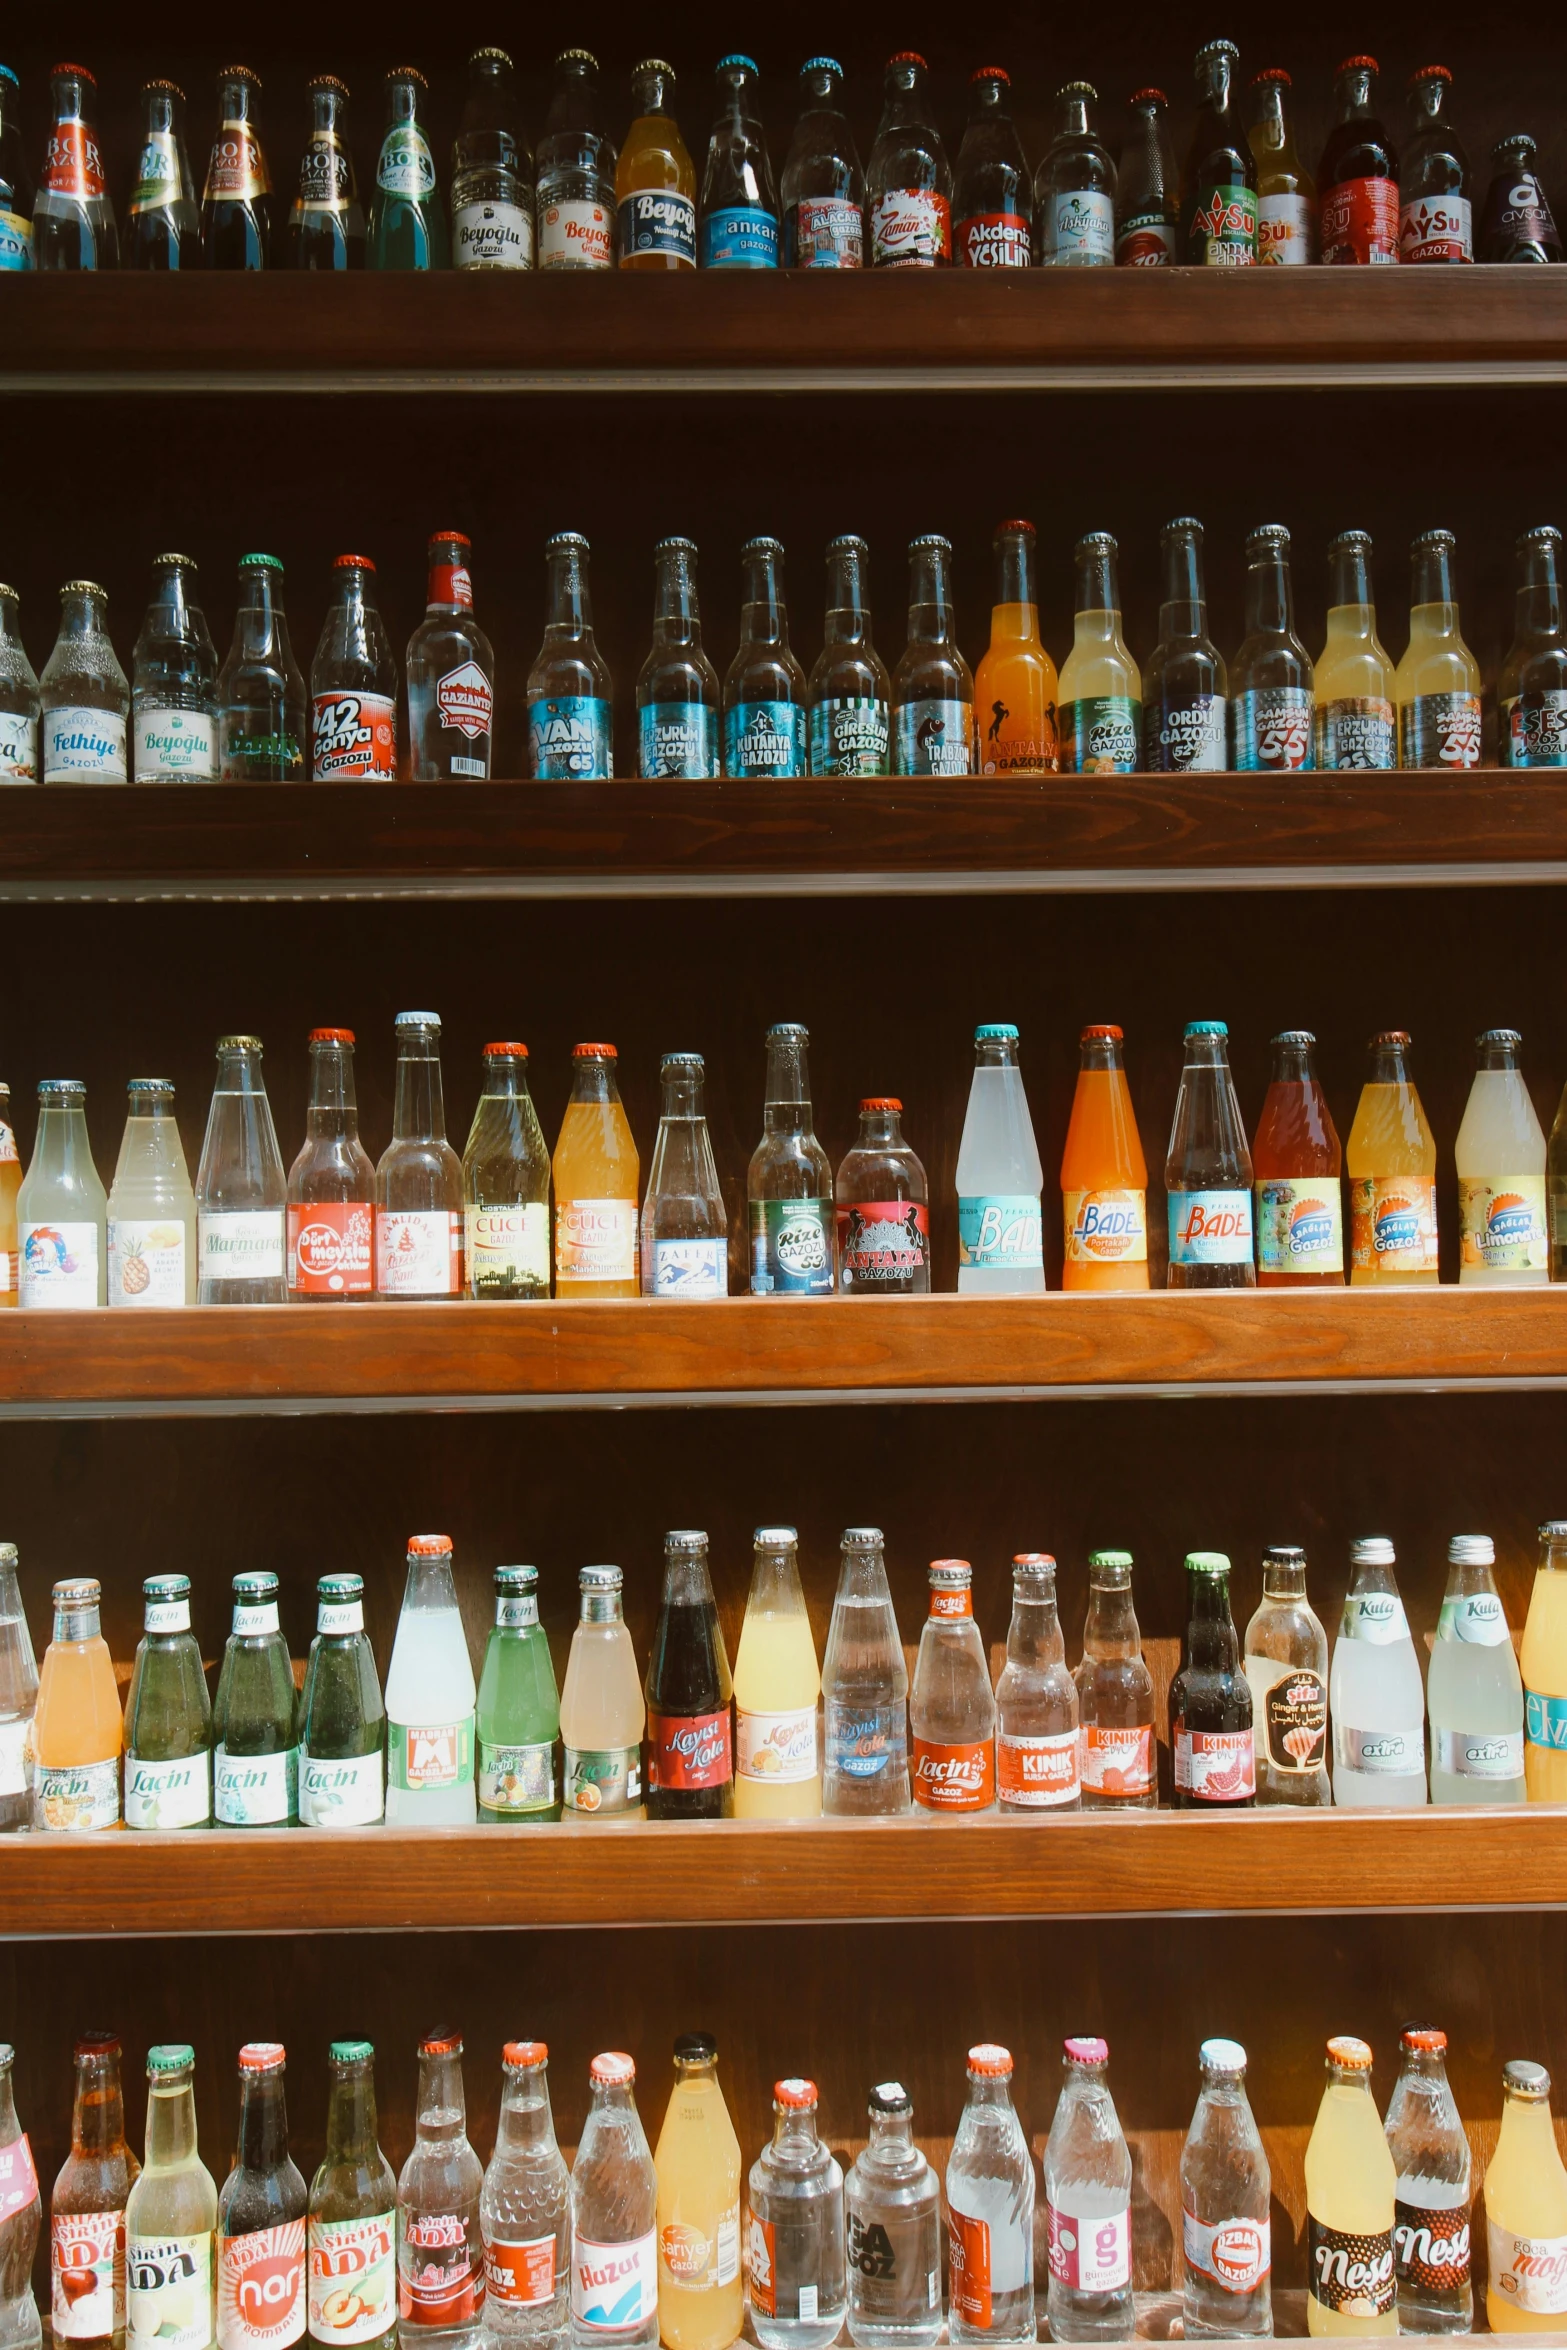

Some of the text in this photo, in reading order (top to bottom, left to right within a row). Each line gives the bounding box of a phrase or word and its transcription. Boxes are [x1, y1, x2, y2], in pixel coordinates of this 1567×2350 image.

[47, 137, 101, 166] BOR
[211, 142, 258, 166] BOR
[302, 154, 348, 177] BOR
[384, 152, 428, 175] BOR
[878, 211, 921, 241] Zaman
[1059, 215, 1109, 233] Aşkyaka
[1121, 213, 1165, 233] roma
[1258, 220, 1287, 243] SU
[459, 223, 521, 249] Beyoğlu
[967, 222, 1031, 247] Akdeniz
[740, 238, 772, 254] gazozu
[1209, 241, 1253, 258] armut
[1411, 244, 1449, 260] GAZOZ
[1216, 250, 1251, 265] elma
[318, 699, 359, 738] 42
[1168, 710, 1213, 726] ORDU
[1254, 707, 1309, 722] SAMSUN
[535, 717, 593, 744] VAN
[644, 725, 698, 744] ERZURUM
[834, 721, 888, 741] GİRESUN
[1090, 723, 1132, 742] Rize
[1256, 718, 1310, 732] GAZOZU
[1337, 719, 1392, 737] ERZURUM
[53, 732, 117, 758] Fethiye
[145, 732, 209, 754] Beyoğlu
[314, 727, 372, 760] Gonya
[737, 733, 791, 753] KÜTAHYA
[838, 735, 887, 754] GAZOZU
[1089, 737, 1136, 753] GAZOZU
[1159, 726, 1222, 745] GAZOZU
[1257, 730, 1308, 760] 55
[1340, 735, 1390, 751] GAZOZU
[1523, 730, 1560, 746] 1965
[538, 741, 593, 761] gazozu
[646, 741, 695, 760] GAZOZU
[928, 745, 969, 762] TRABZON
[1174, 744, 1191, 756] 52
[1438, 732, 1480, 762] 55
[63, 756, 104, 768] GAZOZU
[159, 752, 192, 763] Gazozu
[322, 751, 372, 772] Gazozu
[569, 754, 593, 772] 65
[740, 749, 788, 767] GAZOZU
[1000, 756, 1052, 769] GAZOZU
[1112, 750, 1134, 764] 53
[931, 761, 968, 775] GAZOZU
[476, 1214, 531, 1233] CÜCE
[1074, 1206, 1142, 1241] BADE
[1177, 1205, 1251, 1244] BADE
[300, 1230, 332, 1246] Dört
[490, 1234, 516, 1244] GAZOZ
[580, 1233, 608, 1243] GAZOZ
[777, 1226, 821, 1247] Rize
[1290, 1236, 1335, 1254] Gazoz
[1374, 1235, 1423, 1252] Gazoz
[311, 1242, 370, 1259] mevsim
[660, 1248, 713, 1262] ZAFER
[778, 1241, 825, 1258] GAZOZU
[846, 1248, 924, 1268] ANTALYA
[800, 1254, 824, 1269] 53
[857, 1266, 914, 1279] GAZOZU
[498, 1603, 532, 1621] Laçin
[1359, 1600, 1394, 1616] Kula
[1467, 1601, 1499, 1616] Kula
[1287, 1685, 1318, 1705] şifa
[1271, 1702, 1306, 1713] Ginger &
[782, 1735, 813, 1757] Kola
[855, 1734, 885, 1756] Kola
[1096, 1729, 1141, 1746] KINIK
[1203, 1736, 1245, 1751] KINIK
[1362, 1737, 1404, 1757] extra
[685, 1737, 724, 1769] Kola
[1466, 1740, 1509, 1761] extra
[844, 1759, 878, 1772] Gazoz
[916, 1755, 969, 1782] Laçin
[1022, 1751, 1073, 1773] KINIK
[130, 1769, 191, 1797] Laçin
[214, 1767, 268, 1794] Laçin
[301, 1766, 358, 1793] Laçin
[932, 1787, 962, 1796] GAZOZ
[407, 2222, 466, 2246] ADA
[228, 2241, 269, 2269] ADA
[313, 2231, 391, 2278] ADA
[659, 2233, 713, 2258] Sarıyer
[1513, 2240, 1548, 2256] goca
[485, 2260, 516, 2287] ZOZ
[579, 2252, 641, 2291] Huzur
[670, 2258, 699, 2272] Gazoz
[1085, 2263, 1126, 2282] günseven
[240, 2265, 298, 2307] nar
[1096, 2276, 1119, 2289] gazoz
[243, 2311, 298, 2340] BOMBASI
